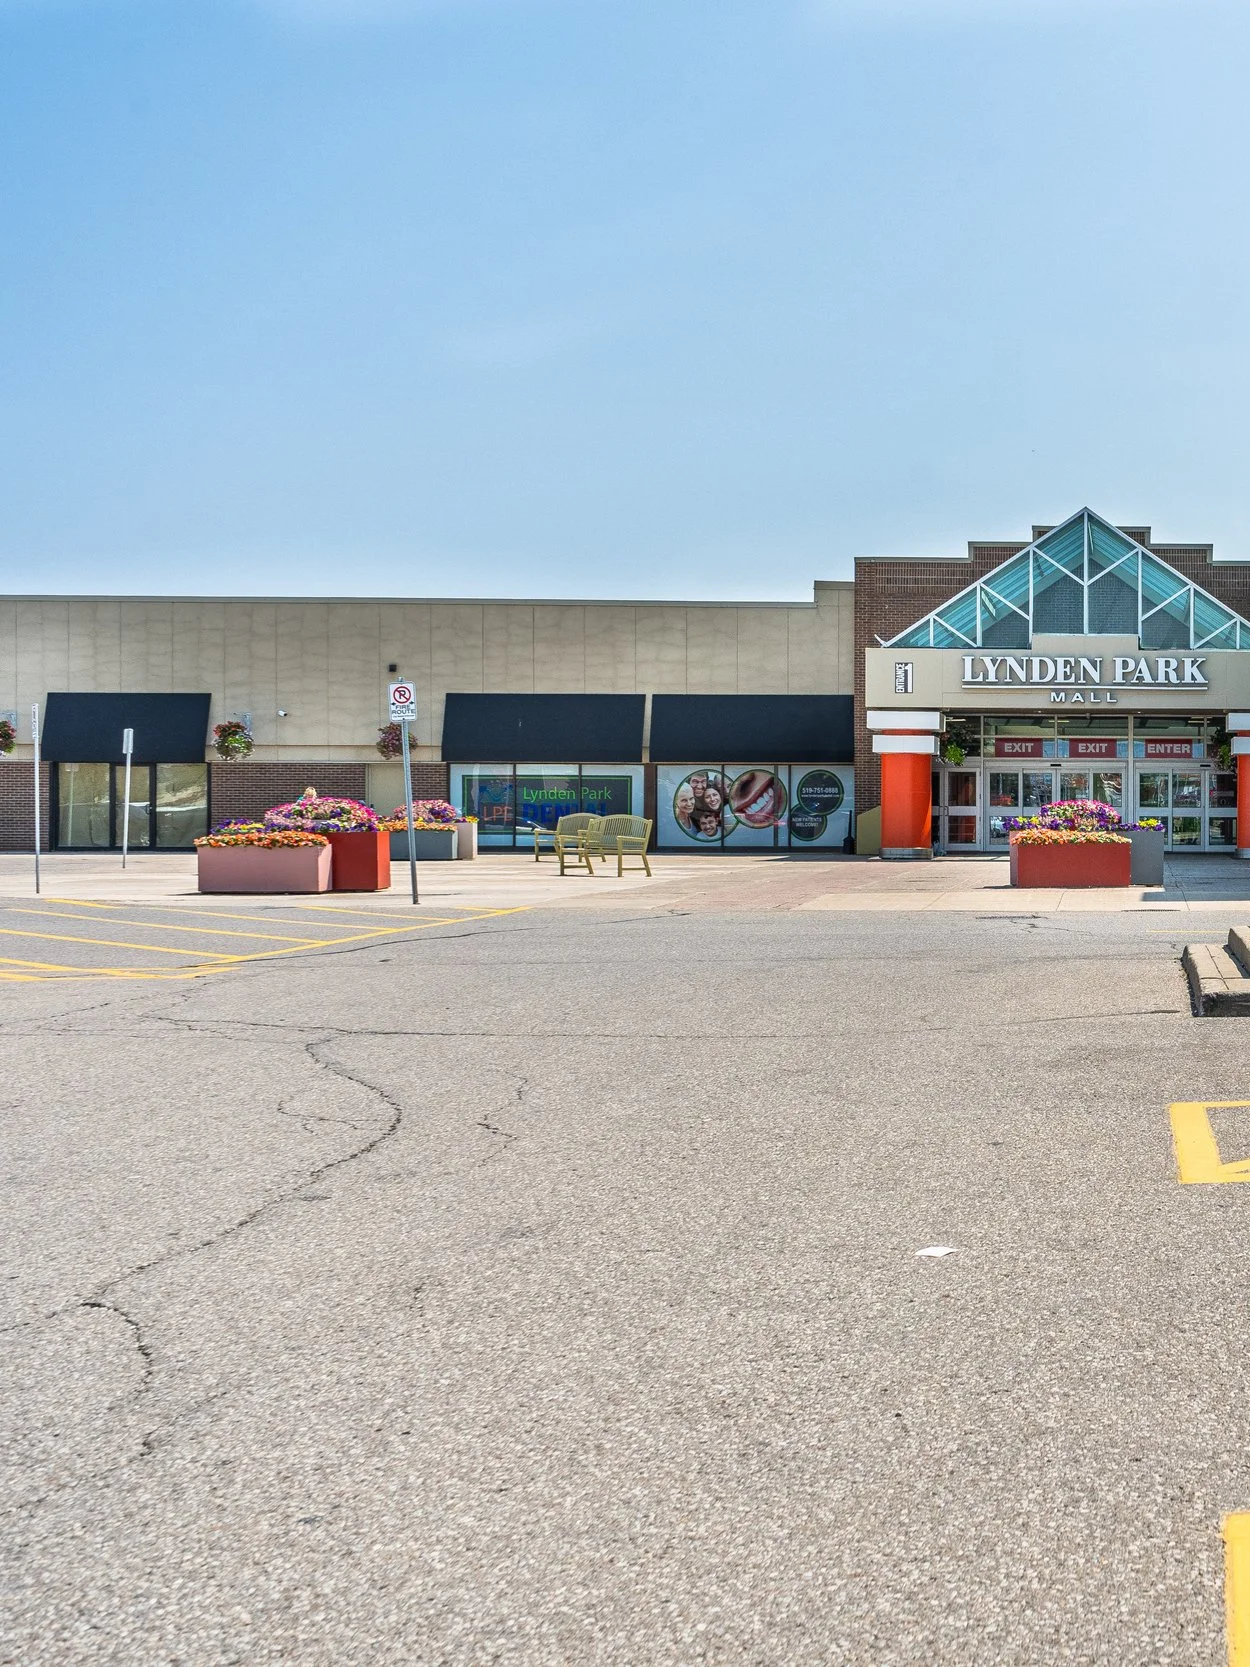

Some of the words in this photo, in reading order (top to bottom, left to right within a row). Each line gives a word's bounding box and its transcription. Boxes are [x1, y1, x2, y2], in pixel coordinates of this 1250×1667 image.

[961, 656, 1103, 684] LYNDEN
[1112, 657, 1209, 684] PARK
[895, 663, 905, 693] ENTRANCE
[905, 663, 913, 693] 1
[1050, 691, 1118, 703] MALL
[1004, 742, 1034, 753] EXIT
[1078, 743, 1108, 753] EXIT
[1147, 743, 1191, 754] ENTER
[523, 786, 576, 802] Lynden
[581, 786, 612, 800] Park
